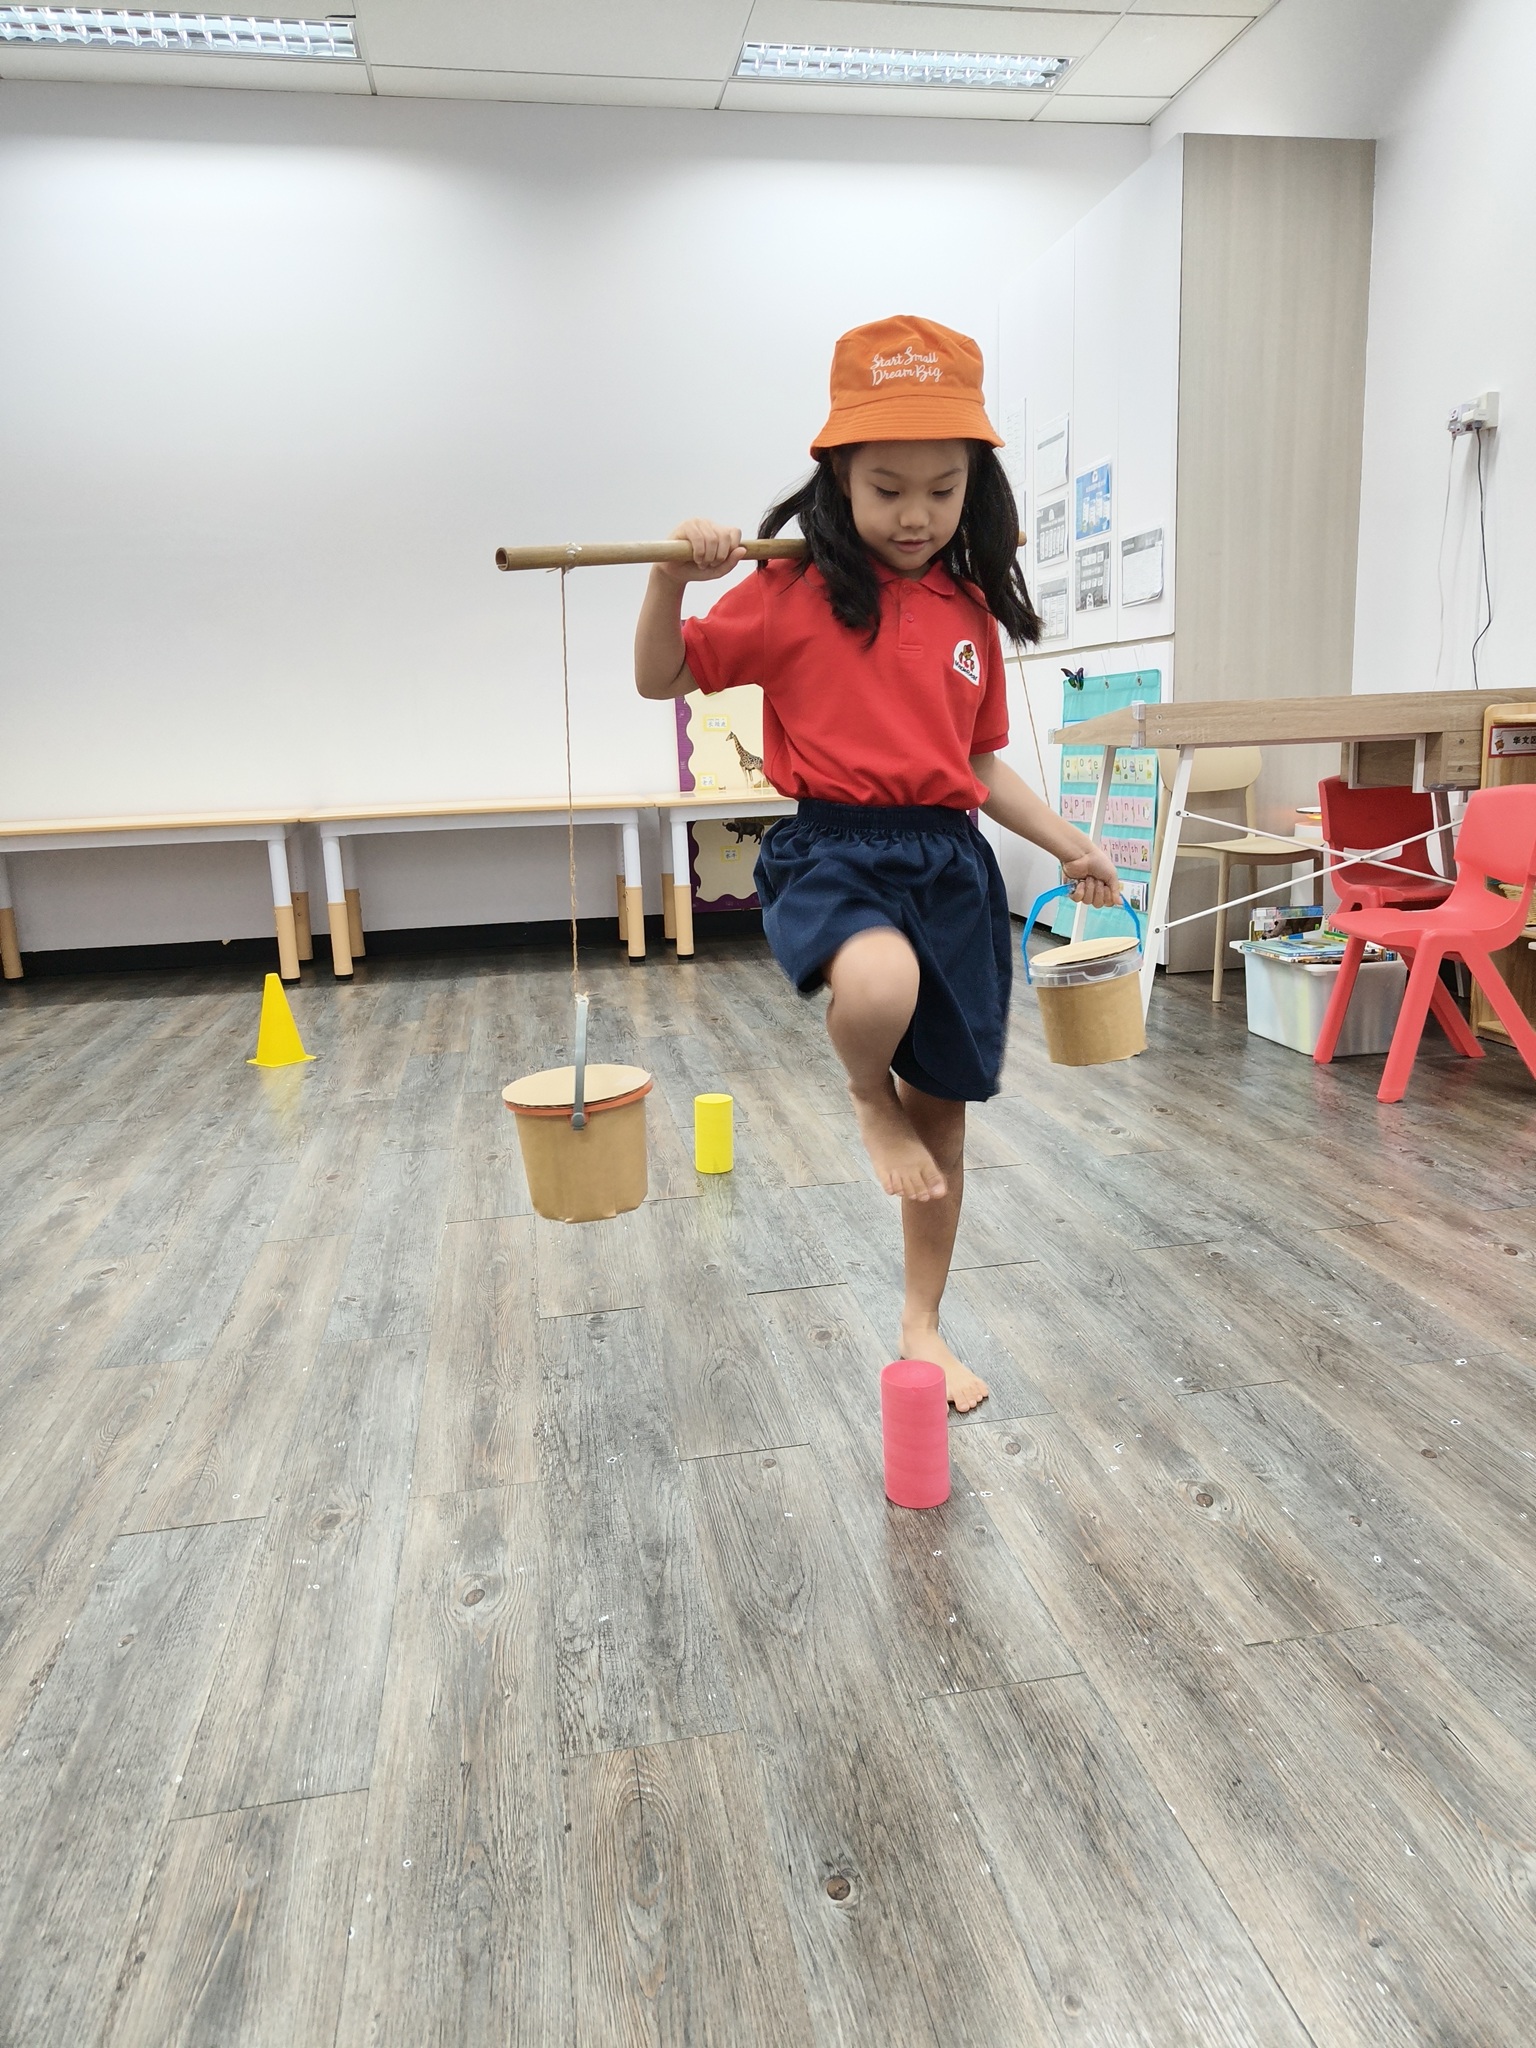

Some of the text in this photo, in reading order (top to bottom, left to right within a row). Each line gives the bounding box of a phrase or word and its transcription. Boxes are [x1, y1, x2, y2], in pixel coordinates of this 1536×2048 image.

[870, 346, 938, 370] Start Small
[872, 364, 943, 386] Dream Big
